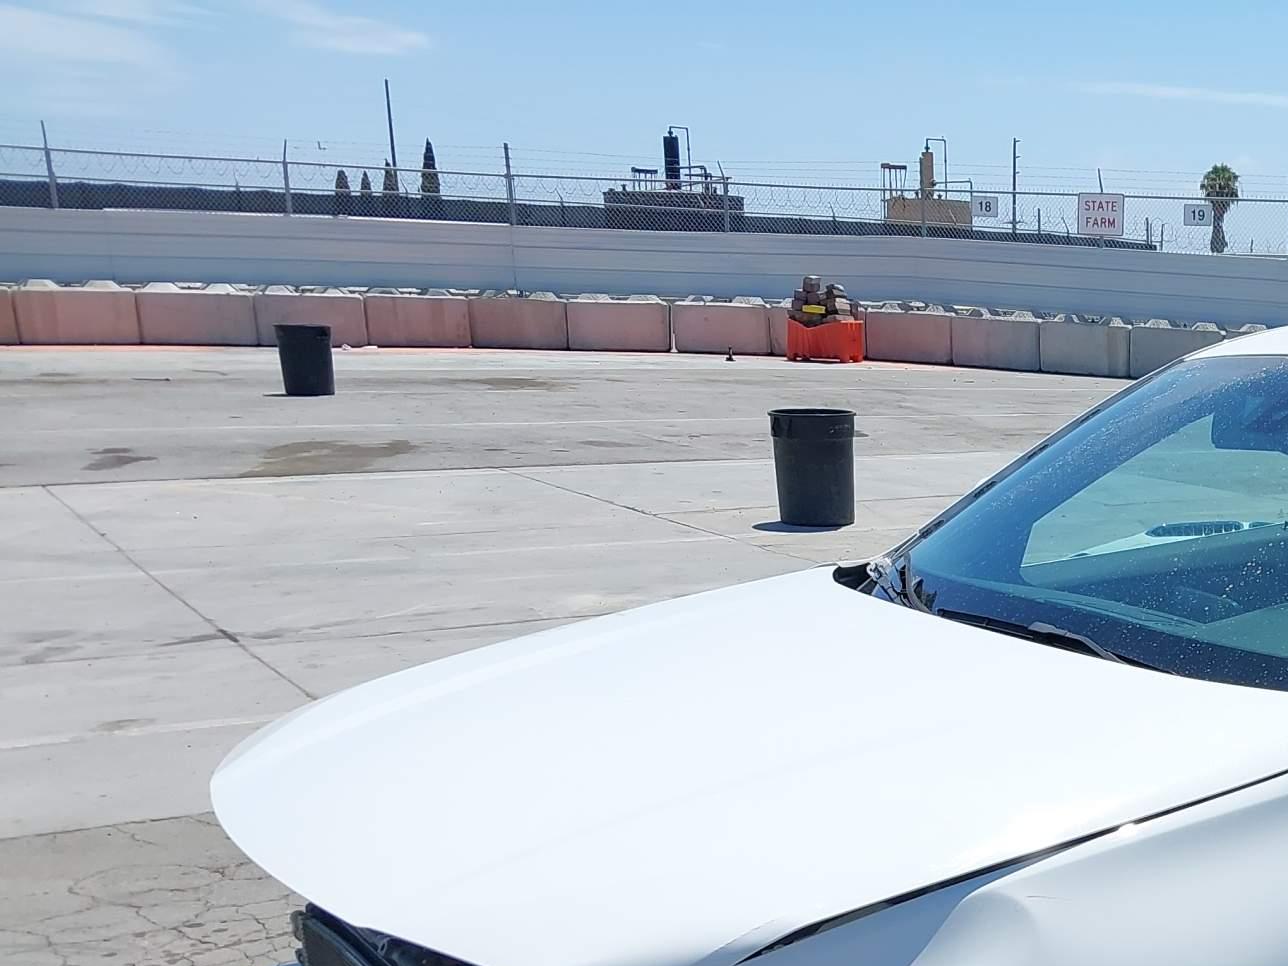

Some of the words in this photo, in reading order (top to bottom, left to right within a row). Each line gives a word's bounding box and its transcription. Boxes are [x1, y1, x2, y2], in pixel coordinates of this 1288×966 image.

[977, 200, 992, 213] 18
[1084, 200, 1118, 213] STATE
[1190, 209, 1206, 221] 19
[1085, 216, 1117, 229] FARM
